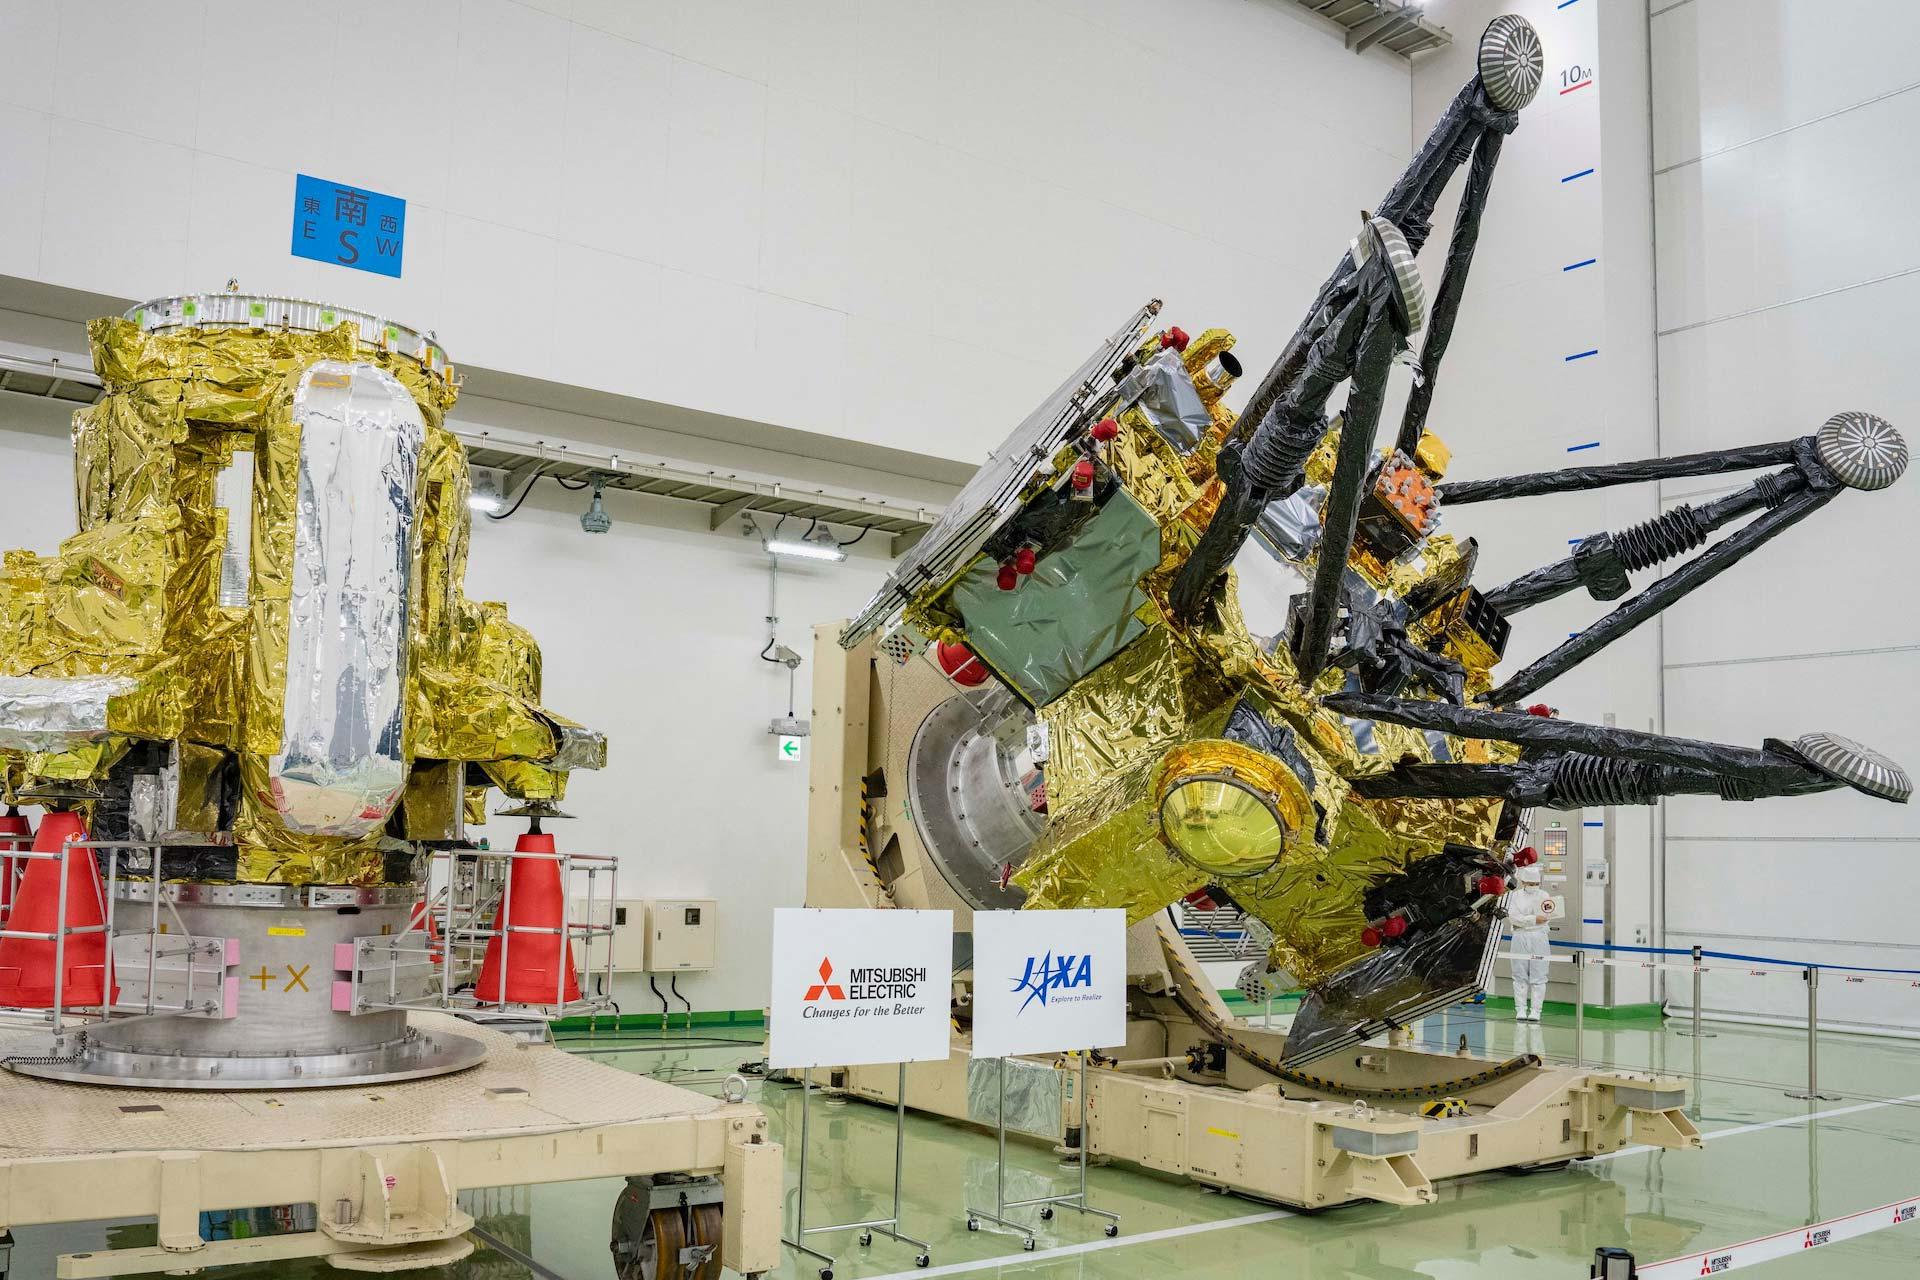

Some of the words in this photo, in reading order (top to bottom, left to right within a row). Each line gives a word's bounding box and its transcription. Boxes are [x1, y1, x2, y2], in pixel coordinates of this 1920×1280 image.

[304, 196, 320, 215] 東
[336, 189, 369, 226] 南
[303, 220, 316, 239] E
[381, 215, 398, 233] 西
[337, 230, 359, 264] S
[376, 236, 399, 256] W
[849, 967, 927, 984] MITSUBISHI
[1008, 949, 1092, 1017] JAXA
[849, 983, 917, 1000] ELECTRIC
[1051, 995, 1073, 1003] Explore
[1081, 993, 1103, 1002] Realize
[802, 1005, 852, 1020] Changes
[853, 1005, 871, 1018] for
[873, 1004, 890, 1016] the
[893, 1003, 926, 1016] Better
